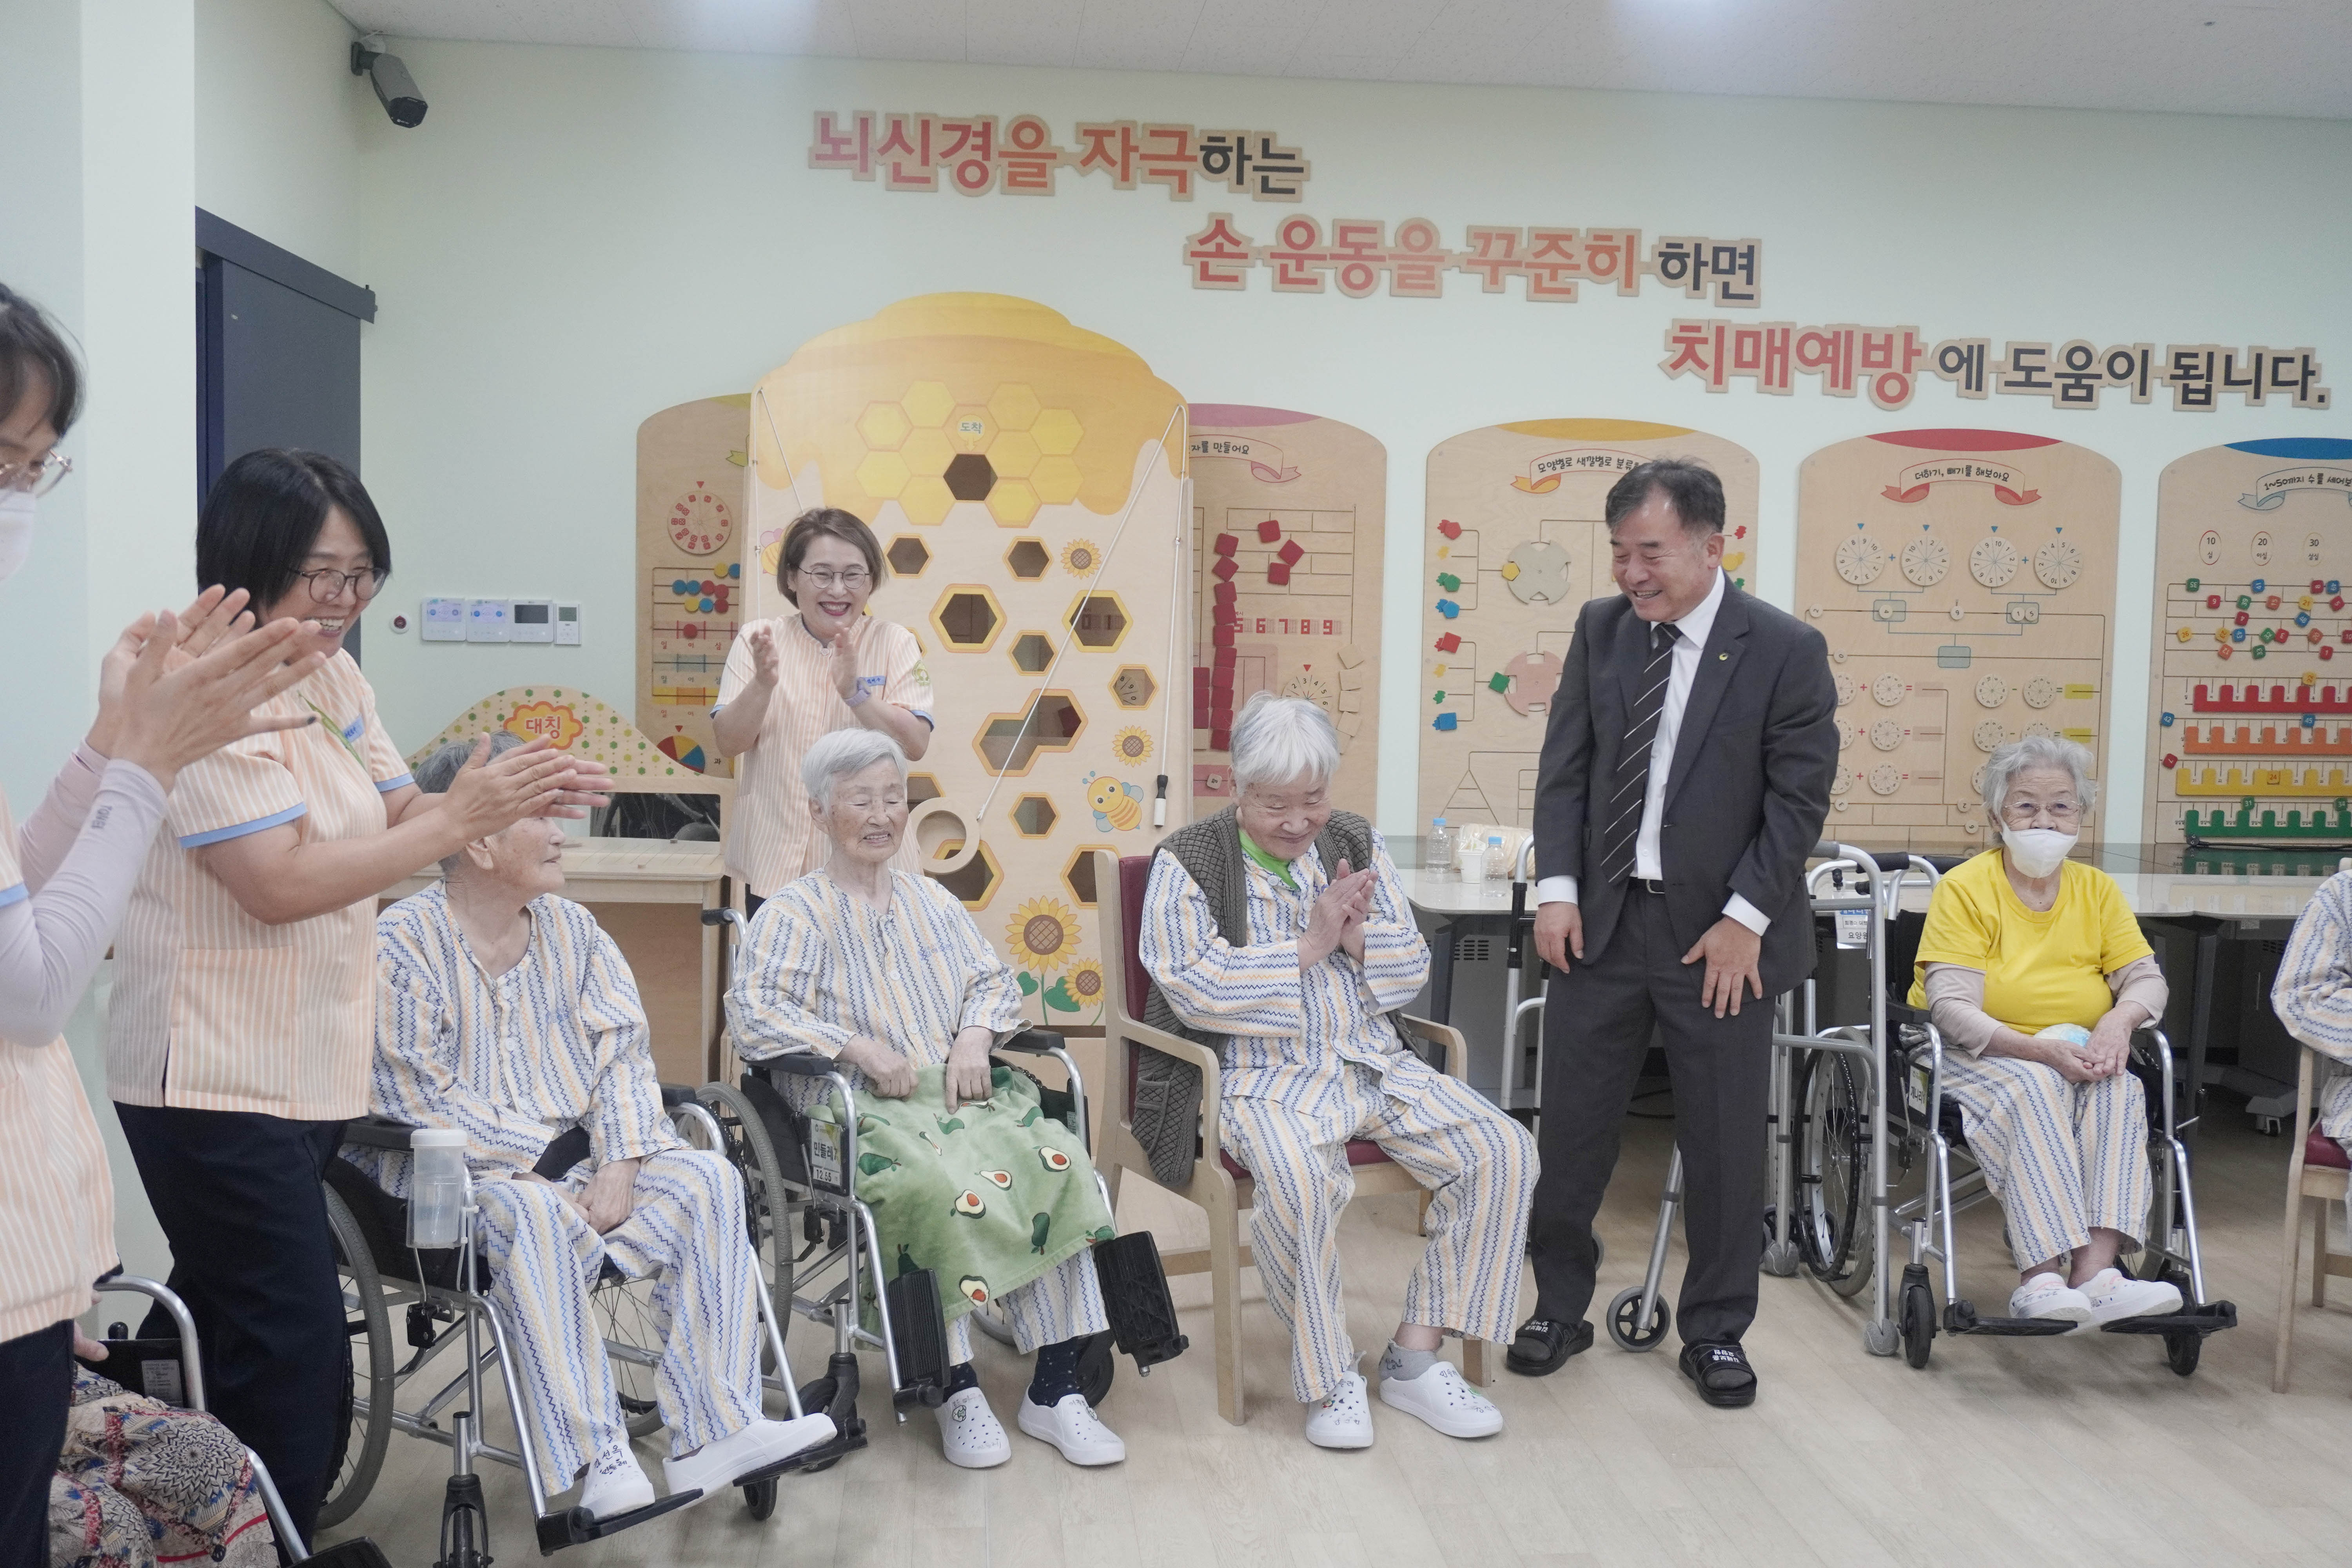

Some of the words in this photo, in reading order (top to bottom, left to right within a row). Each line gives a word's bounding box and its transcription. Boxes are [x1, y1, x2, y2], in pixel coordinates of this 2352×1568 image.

[813, 116, 1057, 189] 뇌신경을
[1080, 125, 1305, 198] 자극하는
[1190, 218, 1248, 284] 손
[1270, 219, 1445, 293] 운동을
[1466, 229, 1637, 297] 꾸준히
[1659, 240, 1756, 301] 하면
[2005, 343, 2150, 404] 도움이
[2170, 350, 2327, 406] 됩니다.
[960, 421, 983, 435] 도착
[1189, 440, 1209, 453] 자를
[1213, 441, 1250, 455] 만들어요
[1538, 457, 1573, 473] 모양별로
[1576, 456, 1612, 468] 색깔별로
[1915, 468, 1945, 480] 더하기,
[1947, 465, 1973, 477] 빼기를
[1976, 467, 2010, 483] 해보아요
[2264, 476, 2305, 490] 1~50까지
[2308, 473, 2324, 485] 수를
[2258, 538, 2268, 546] 20
[2309, 539, 2319, 547] 30
[2256, 552, 2268, 560] 이십
[2308, 552, 2319, 561] 삼십
[1234, 618, 1243, 633] 5
[1256, 618, 1266, 633] 6
[1279, 619, 1288, 634] 7
[1301, 619, 1310, 634] 8
[1323, 620, 1333, 635] 9
[661, 641, 668, 650] 일
[715, 641, 722, 651] 삼
[661, 675, 668, 684] 일
[661, 710, 668, 718] 일
[525, 715, 562, 740] 대칭
